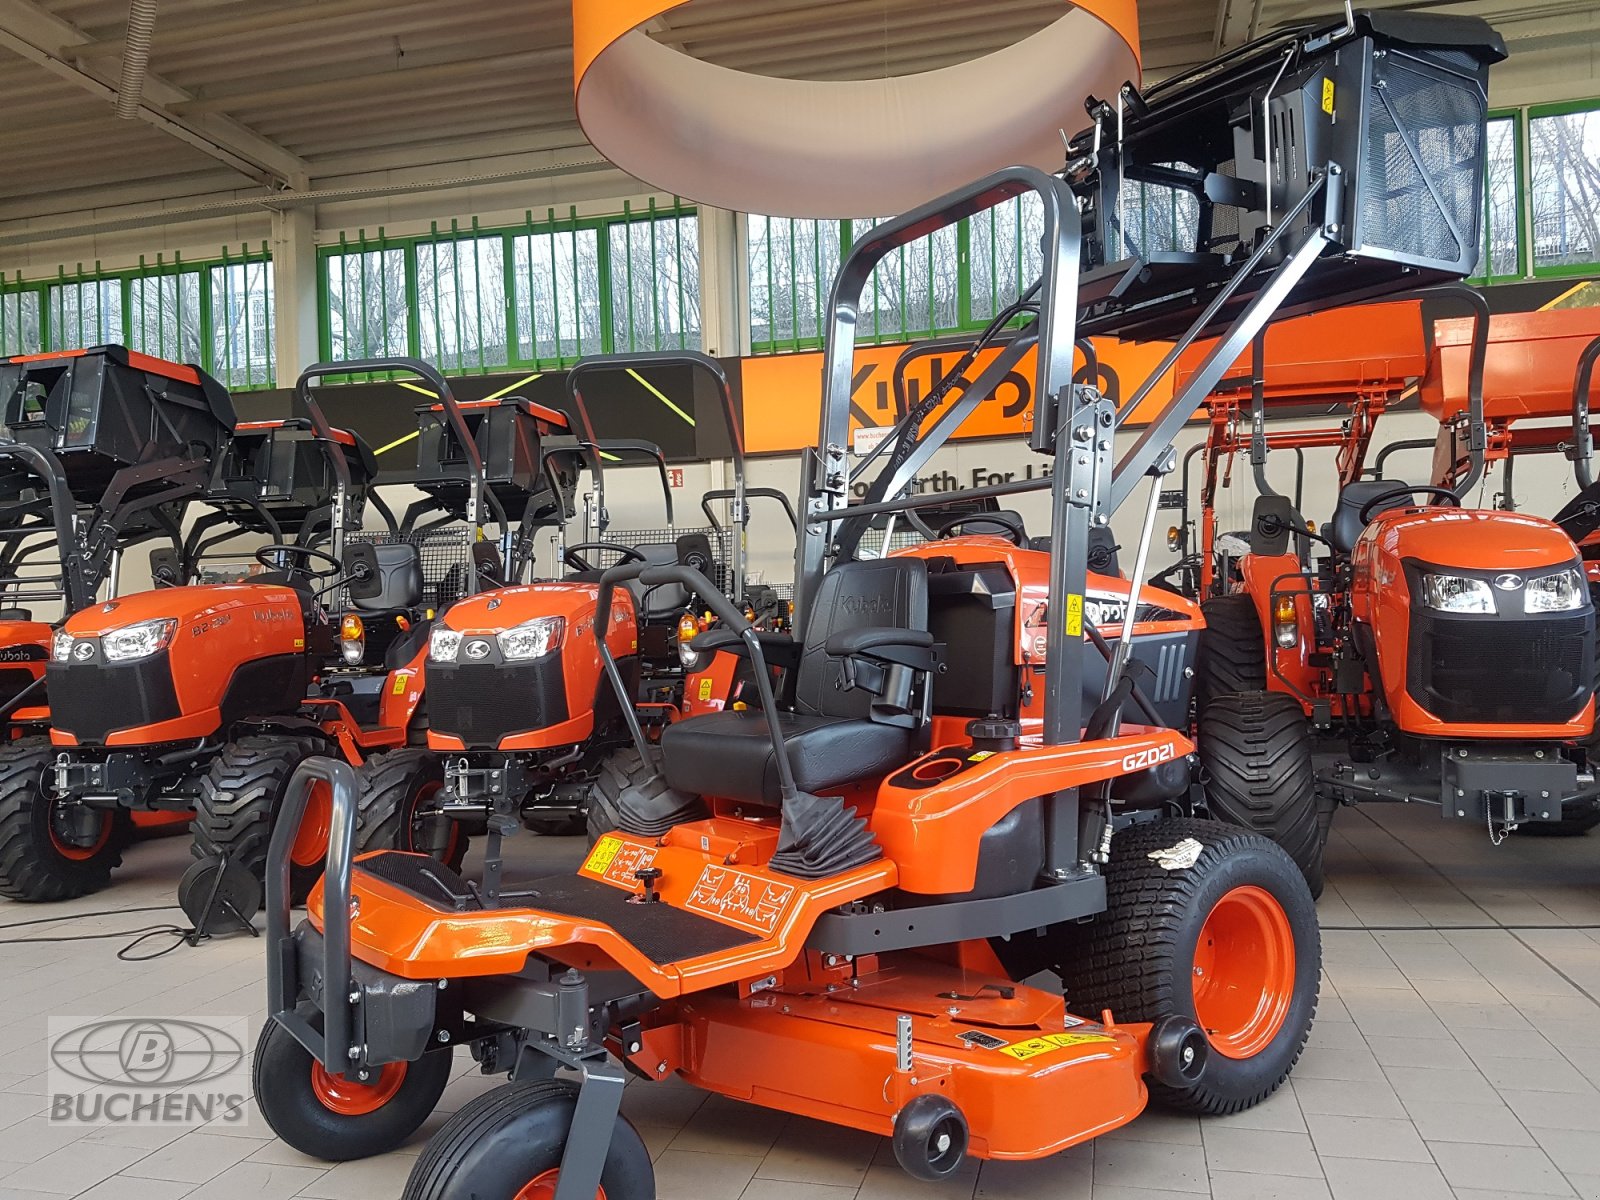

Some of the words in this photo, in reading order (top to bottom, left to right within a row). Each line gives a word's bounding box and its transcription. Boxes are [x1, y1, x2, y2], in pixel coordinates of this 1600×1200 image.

[918, 470, 965, 493] rth,
[972, 467, 1015, 488] For
[0, 650, 31, 661] ubota
[1122, 742, 1174, 772] GZD21
